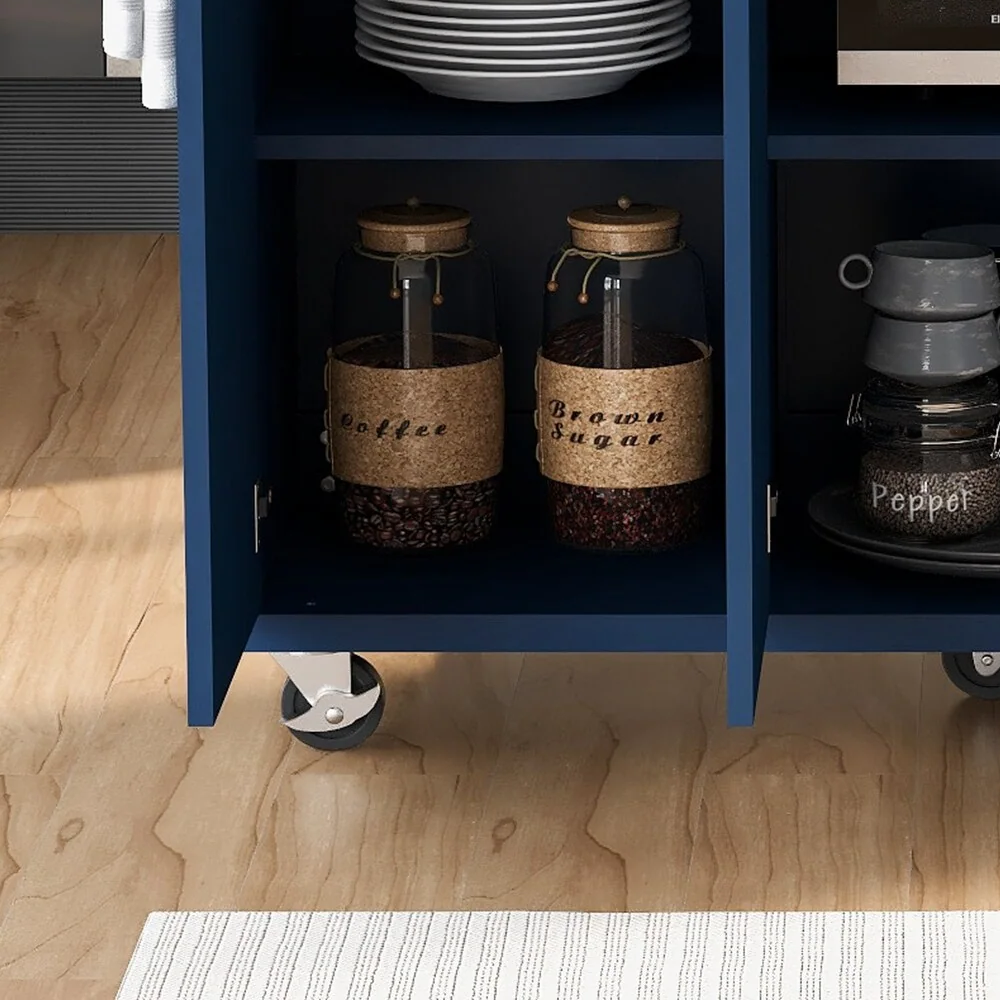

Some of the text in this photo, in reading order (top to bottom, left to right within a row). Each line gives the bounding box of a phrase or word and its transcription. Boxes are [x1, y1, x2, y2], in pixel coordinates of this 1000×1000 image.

[550, 399, 665, 424] Brown
[341, 413, 448, 440] Coffee
[551, 422, 662, 450] Sugar
[872, 481, 973, 523] Pepper
